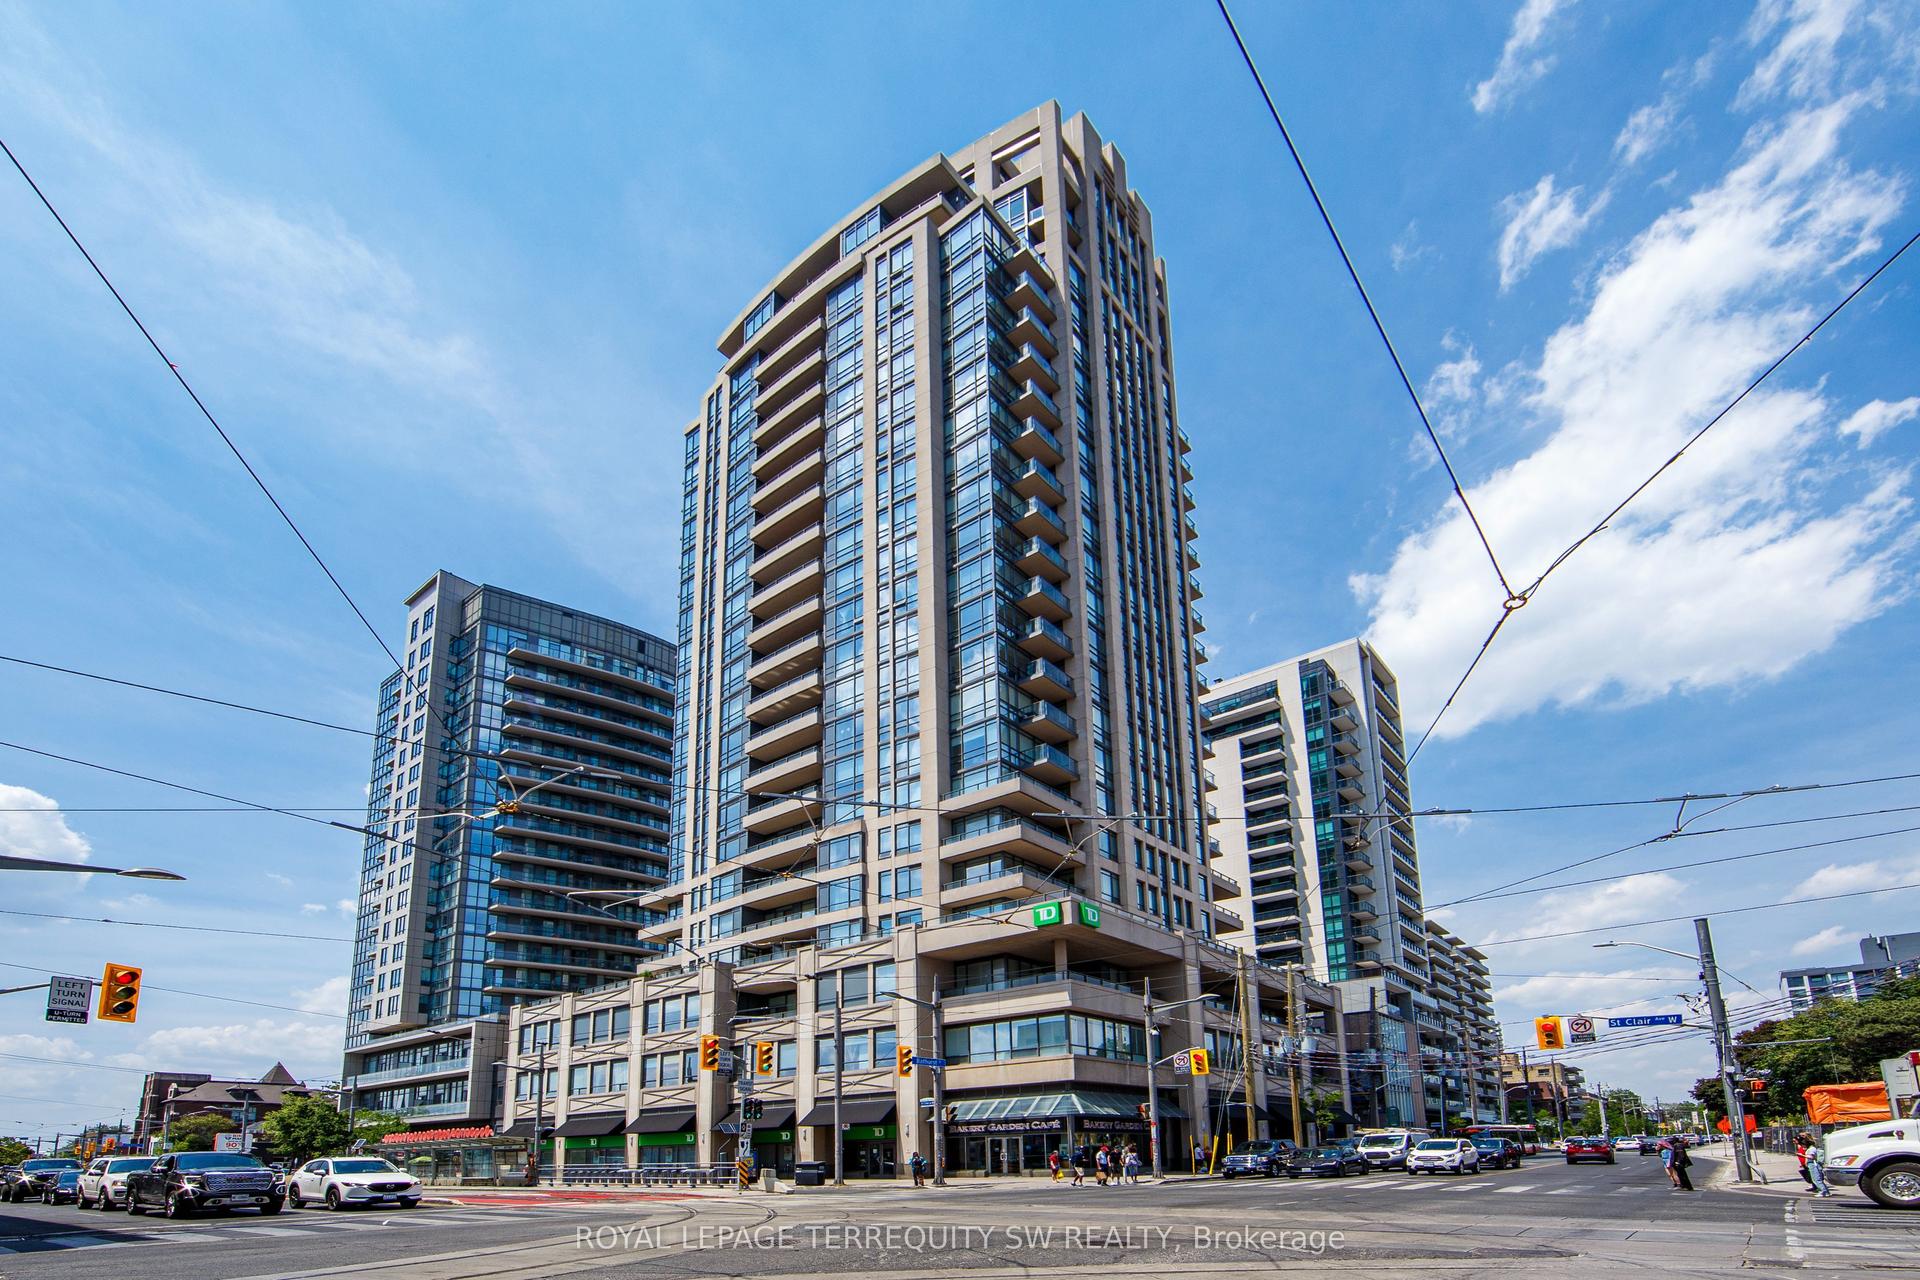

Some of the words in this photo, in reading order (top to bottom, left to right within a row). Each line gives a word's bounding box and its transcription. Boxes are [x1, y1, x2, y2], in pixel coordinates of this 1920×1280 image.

[1035, 906, 1056, 921] TD
[1085, 906, 1098, 922] TD
[58, 981, 85, 990] LEFT
[56, 989, 86, 998] TURN
[51, 998, 87, 1008] SIGNAL
[1610, 1019, 1620, 1027] St
[1625, 1017, 1651, 1026] Clair
[1667, 1016, 1677, 1024] W
[949, 1125, 986, 1133] BAKERY
[987, 1121, 1030, 1131] GARDEN
[1083, 1120, 1113, 1129] BAKERY
[780, 1131, 790, 1140] TD
[873, 1127, 884, 1137] TD
[685, 1134, 694, 1142] TD
